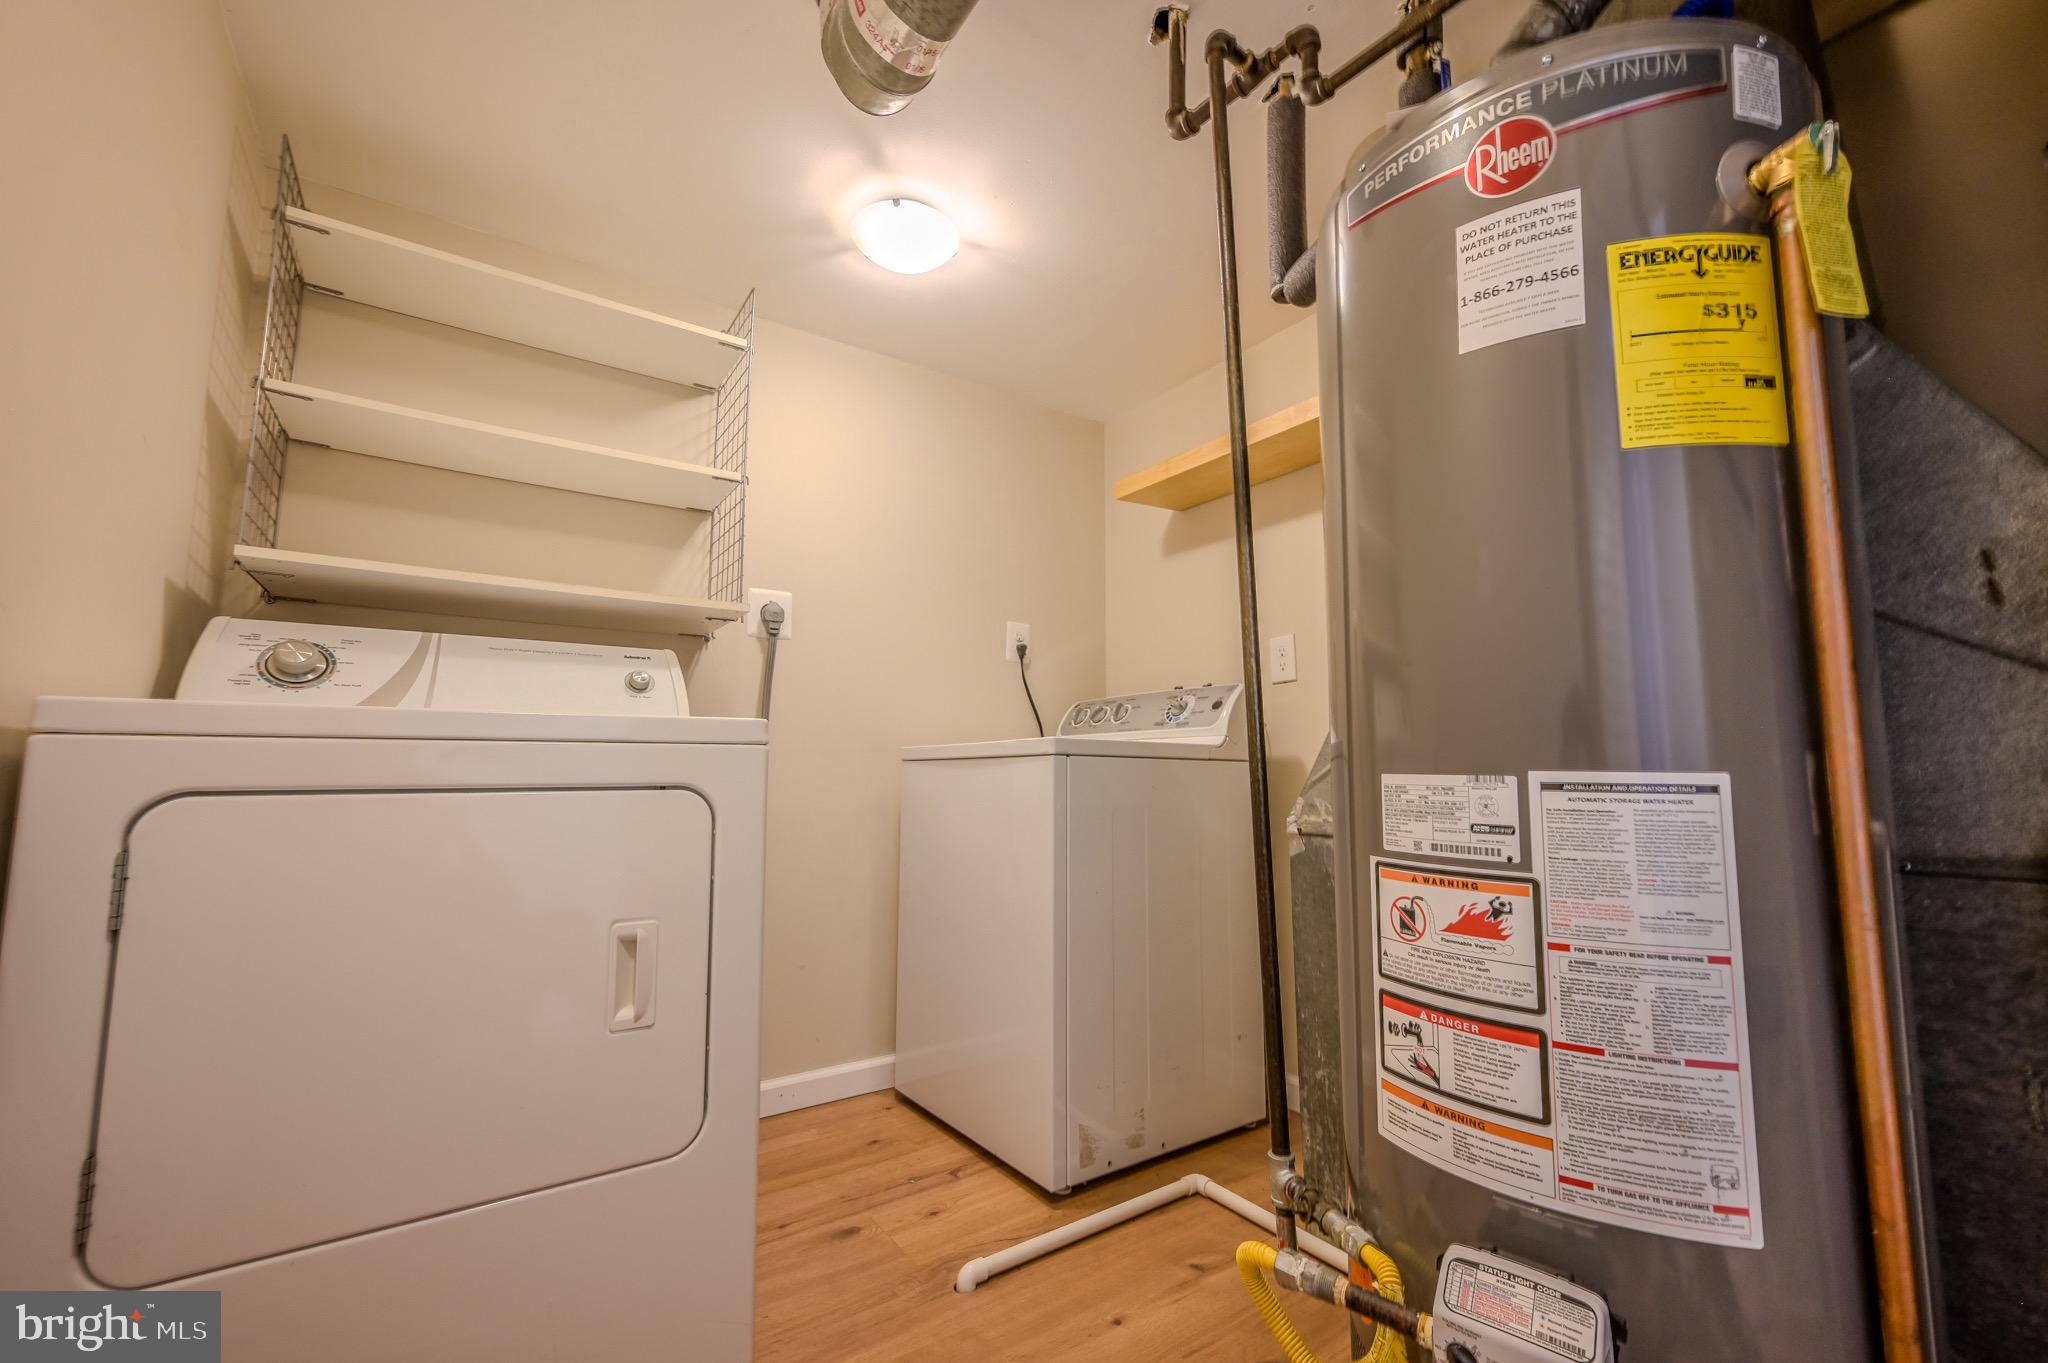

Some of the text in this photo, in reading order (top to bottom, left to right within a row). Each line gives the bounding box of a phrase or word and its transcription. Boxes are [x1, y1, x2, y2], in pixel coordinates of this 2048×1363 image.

[1364, 89, 1533, 199] PERFORMANCE
[1542, 52, 1688, 105] PLATINUM
[1475, 124, 1550, 192] Rheem
[1460, 211, 1577, 254] WATER HEATER TO THE
[1462, 198, 1577, 242] DO NOT RETURN THIS
[1465, 247, 1495, 265] PLACE
[1498, 241, 1512, 252] OF
[1515, 224, 1574, 247] PURCHASE
[1460, 264, 1580, 308] 1-866-279-4566
[1702, 302, 1758, 320] $315
[1422, 876, 1479, 891] WARNING
[1440, 936, 1497, 951] Flammable Vapors
[1588, 948, 1603, 956] YOUR
[1605, 949, 1627, 958] SAFETY
[1430, 1013, 1480, 1034] DANGER
[1434, 1105, 1486, 1131] WARNING
[1478, 1264, 1562, 1299] STATUS LIGHT CODE
[1496, 1279, 1516, 1290] STATUS
